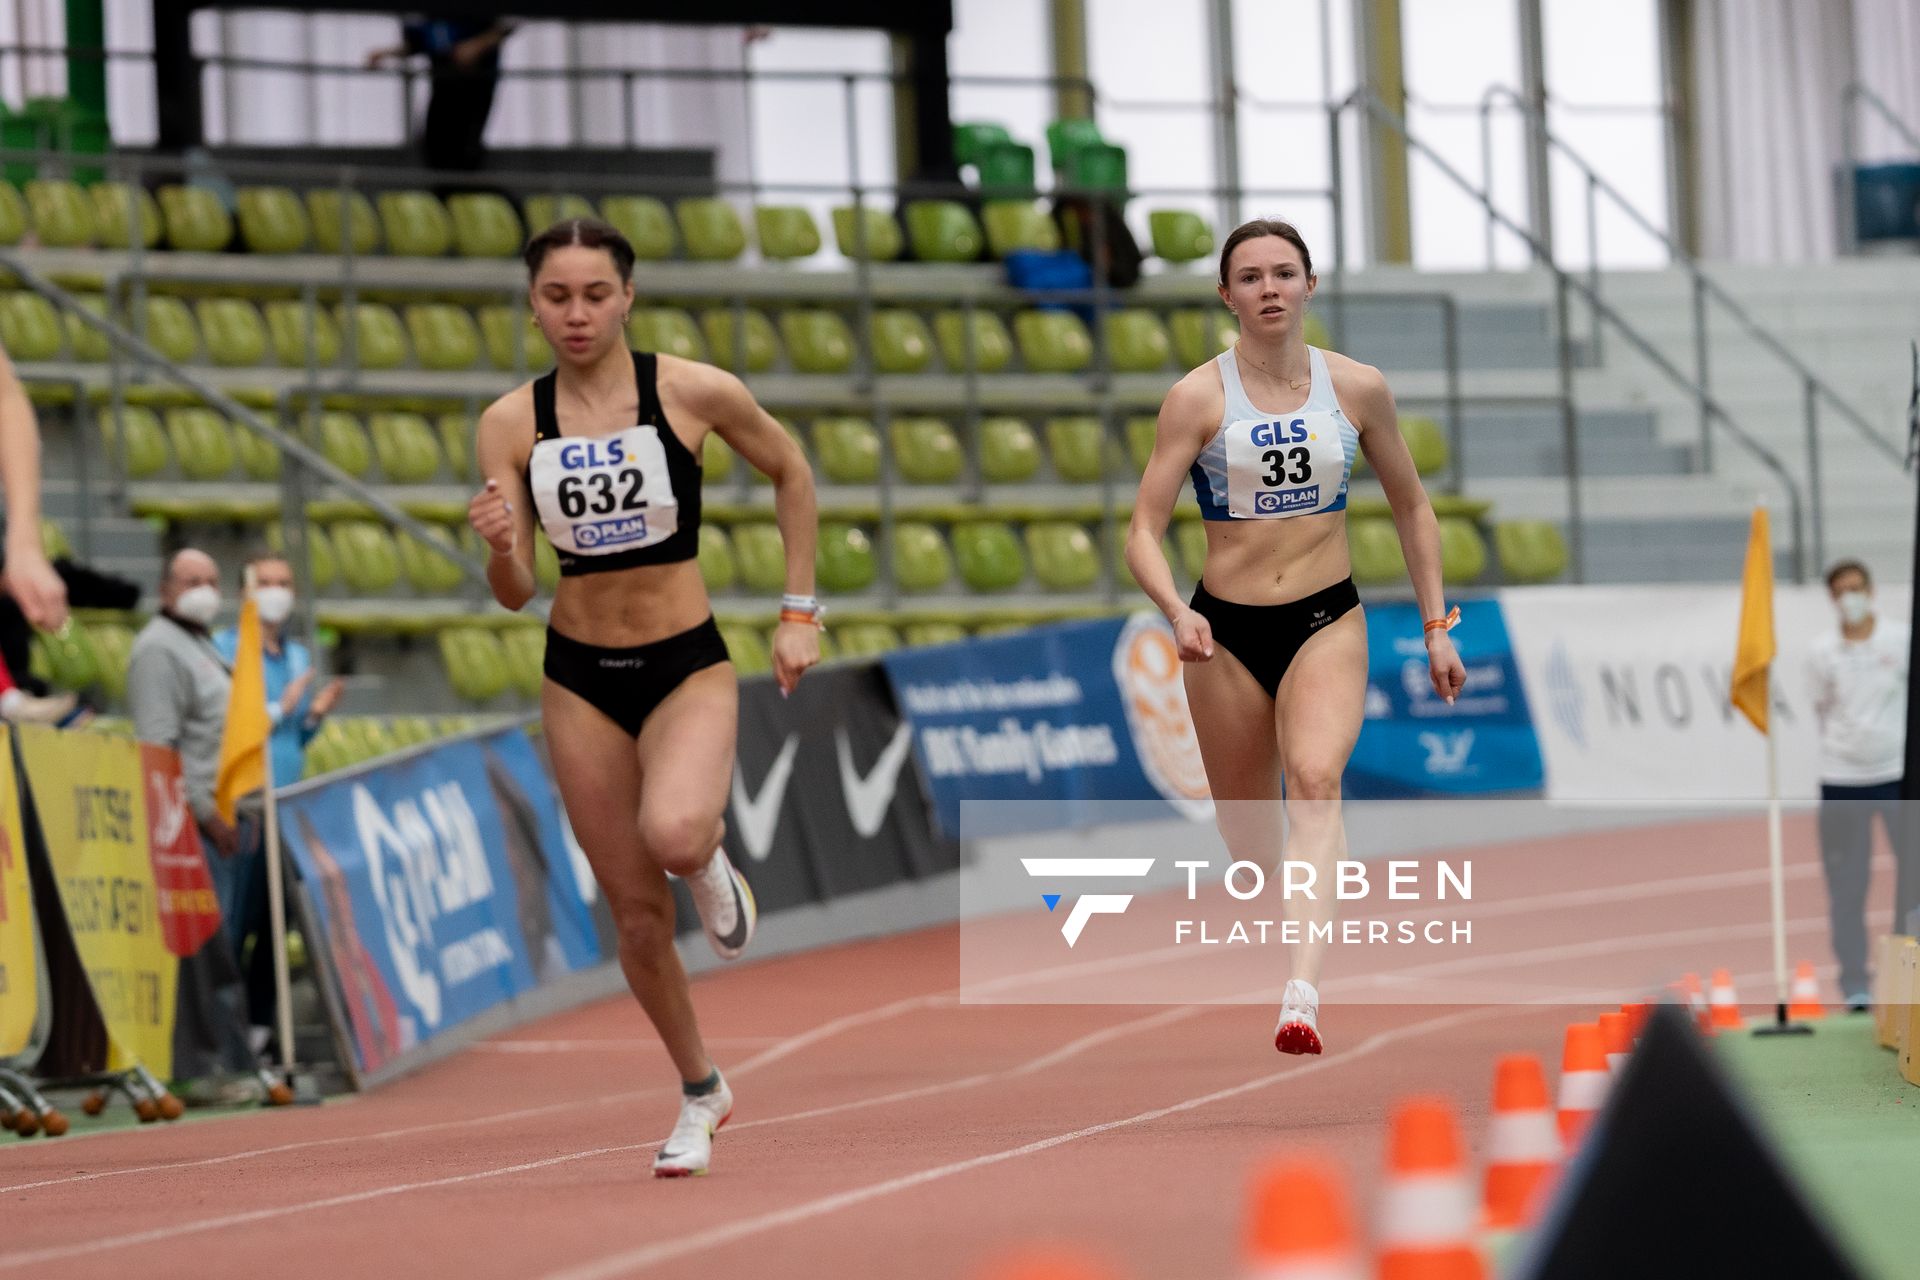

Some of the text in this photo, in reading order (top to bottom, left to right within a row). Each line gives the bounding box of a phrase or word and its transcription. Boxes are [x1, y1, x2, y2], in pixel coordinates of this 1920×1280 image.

[1261, 446, 1312, 487] 33
[558, 468, 648, 518] 632
[1282, 489, 1317, 504] PLAN
[601, 519, 643, 538] PLAN
